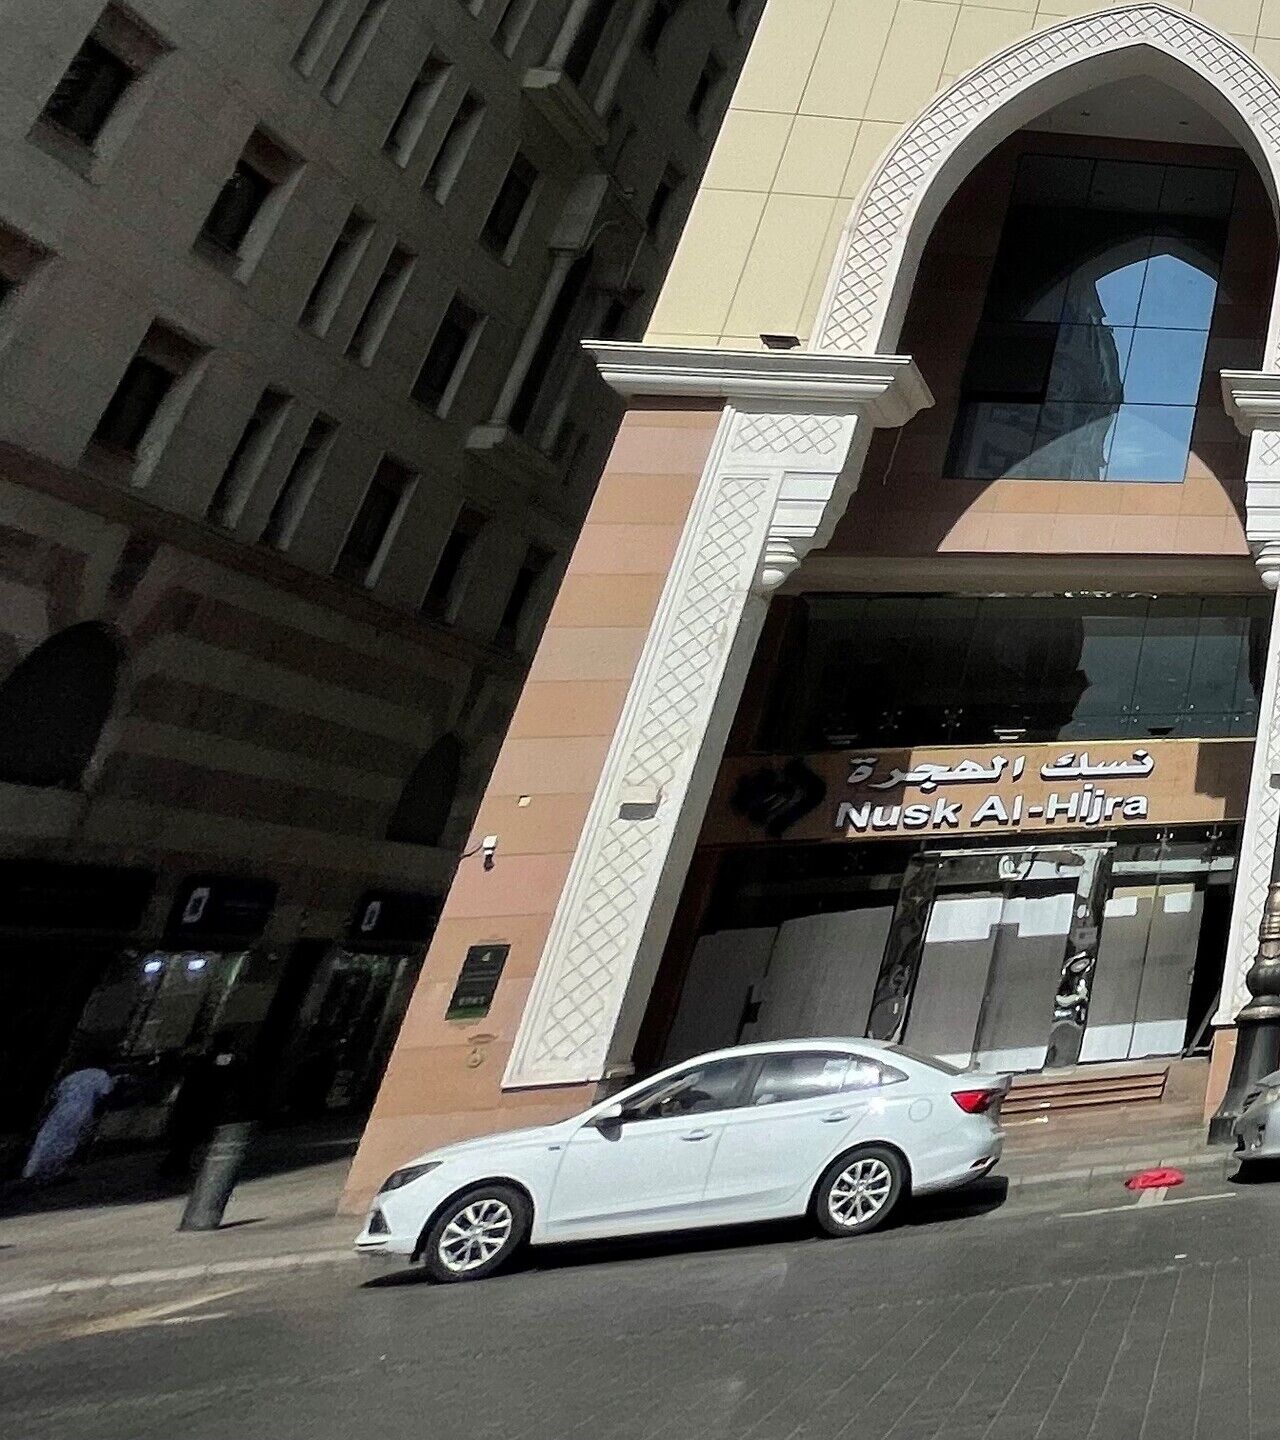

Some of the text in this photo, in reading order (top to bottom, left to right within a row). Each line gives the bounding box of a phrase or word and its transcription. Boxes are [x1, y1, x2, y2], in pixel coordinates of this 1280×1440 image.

[847, 748, 1155, 793] نسك الهجرة
[835, 783, 1149, 830] Nusk Al-Hijra
